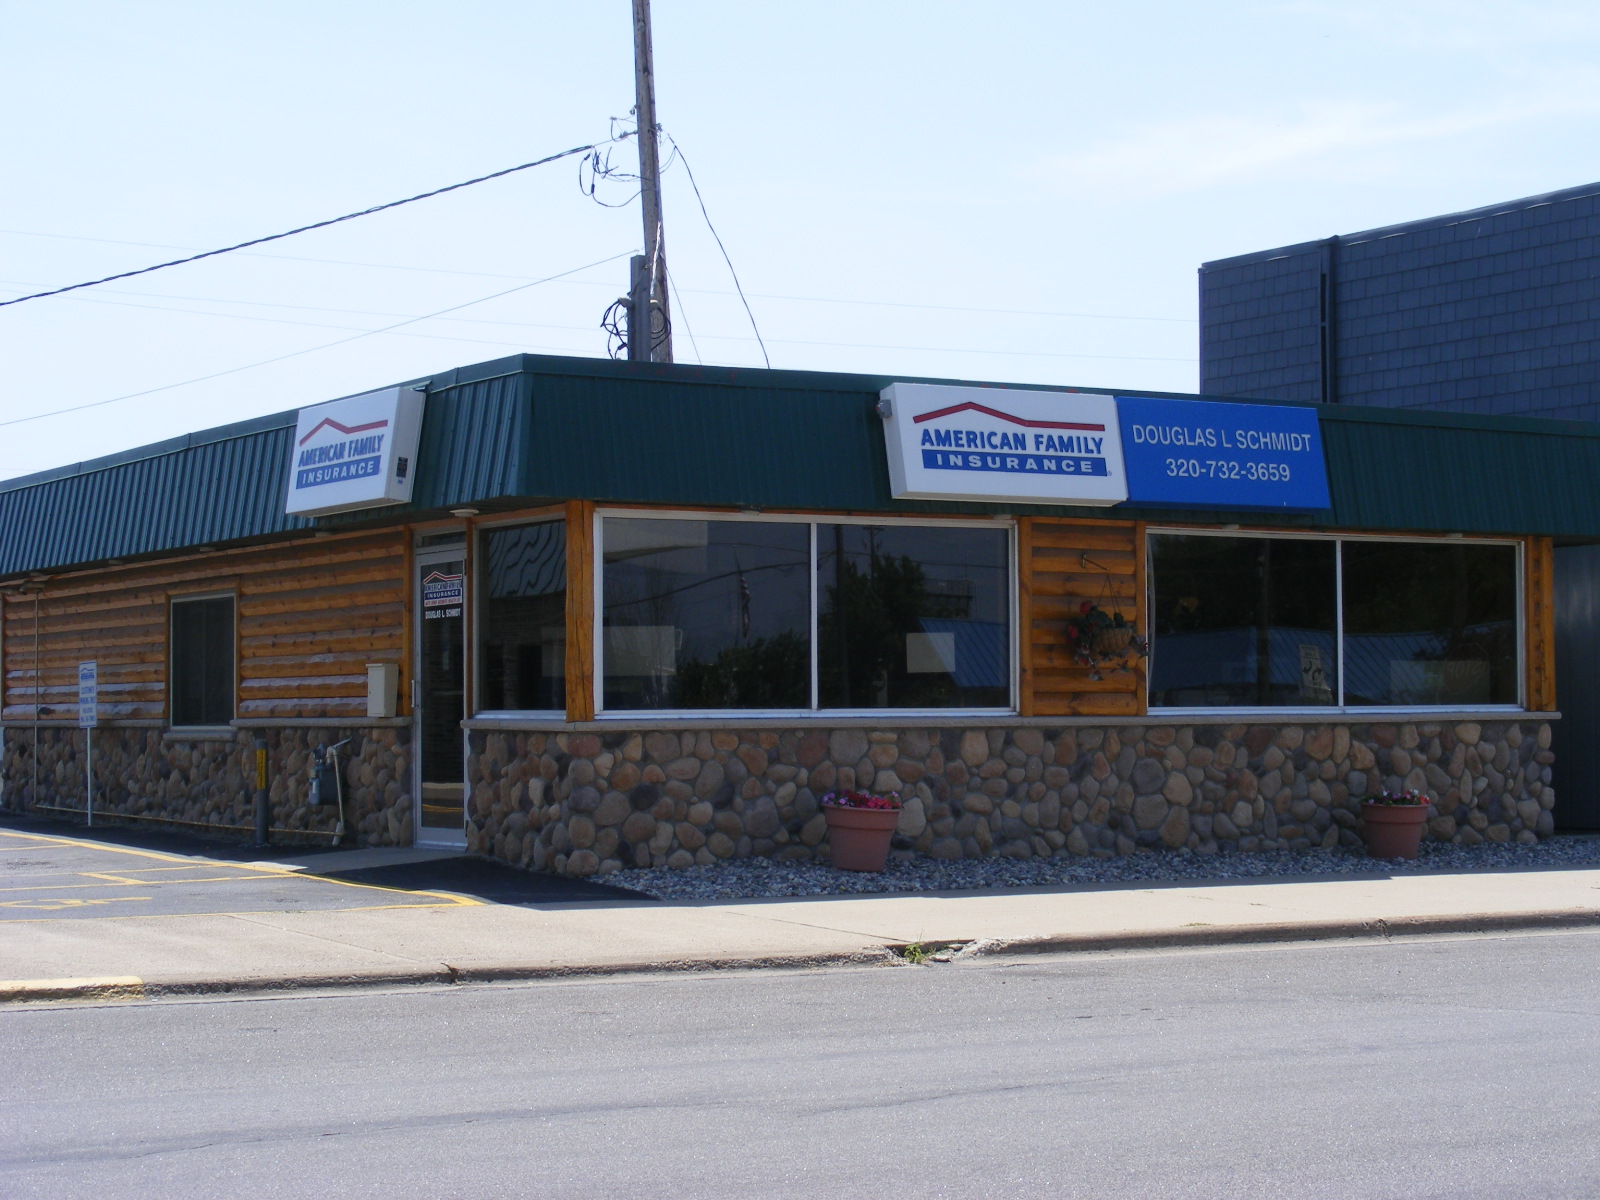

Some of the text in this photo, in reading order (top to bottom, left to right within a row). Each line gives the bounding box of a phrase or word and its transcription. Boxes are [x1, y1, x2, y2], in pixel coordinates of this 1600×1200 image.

[921, 428, 1103, 455] AMERICAN FAMILY
[1132, 424, 1311, 452] DOUGLAS L SCHMIDT
[298, 434, 385, 468] AMERICAN FAMILY
[936, 453, 1093, 472] INSURANCE
[302, 461, 374, 484] INSURANCE
[1165, 458, 1290, 481] 320-732-3659
[428, 590, 458, 598] INSURANCE
